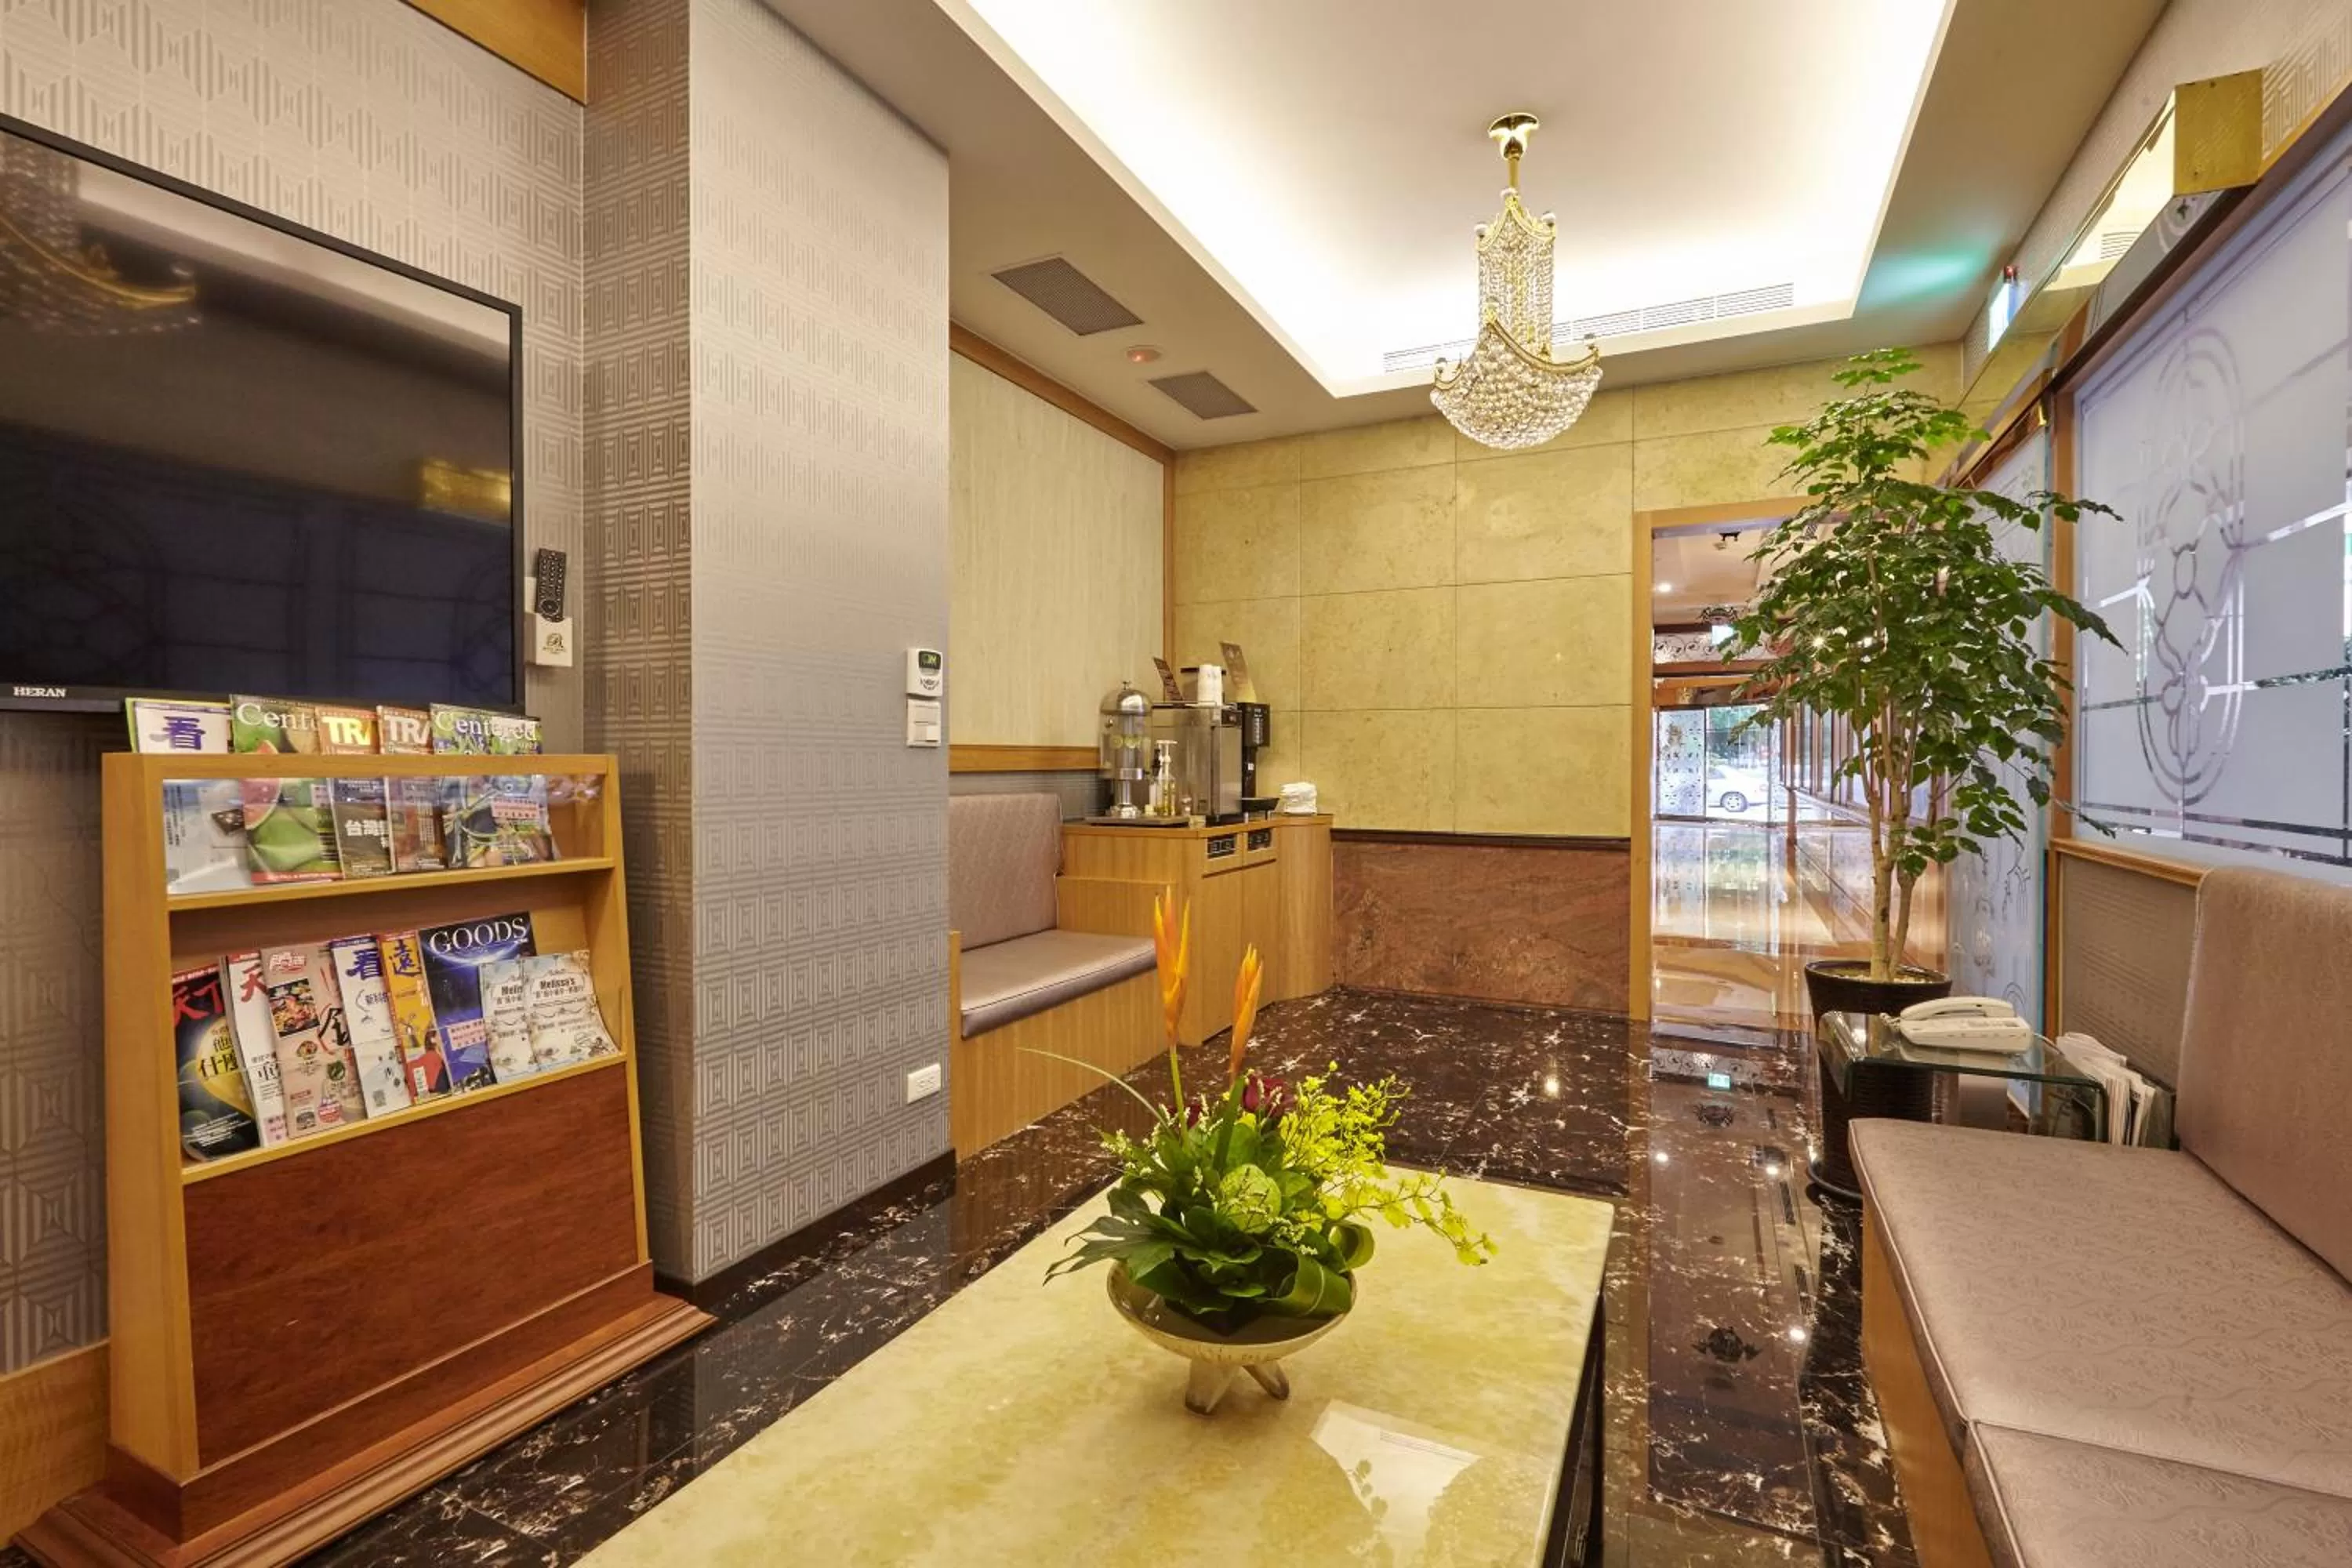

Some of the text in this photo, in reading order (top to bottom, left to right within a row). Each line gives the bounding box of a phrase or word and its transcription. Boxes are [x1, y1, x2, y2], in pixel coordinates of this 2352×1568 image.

[13, 686, 67, 698] HERAN
[150, 716, 206, 750] 看
[430, 917, 527, 954] GOODS
